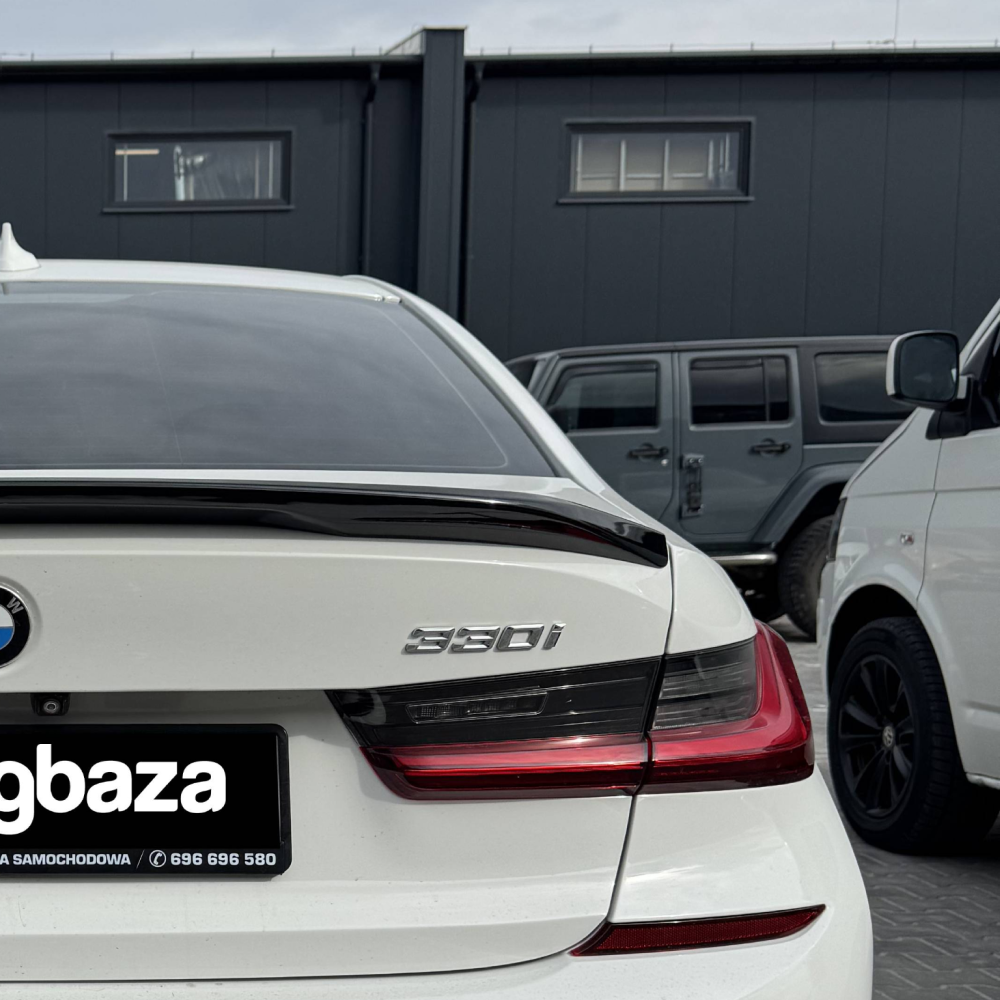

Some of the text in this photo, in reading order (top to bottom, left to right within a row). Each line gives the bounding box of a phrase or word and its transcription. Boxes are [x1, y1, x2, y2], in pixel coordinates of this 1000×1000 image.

[403, 622, 566, 653] 330i
[12, 853, 132, 866] SAMOCHODOWA
[170, 852, 277, 866] 696 696 580
